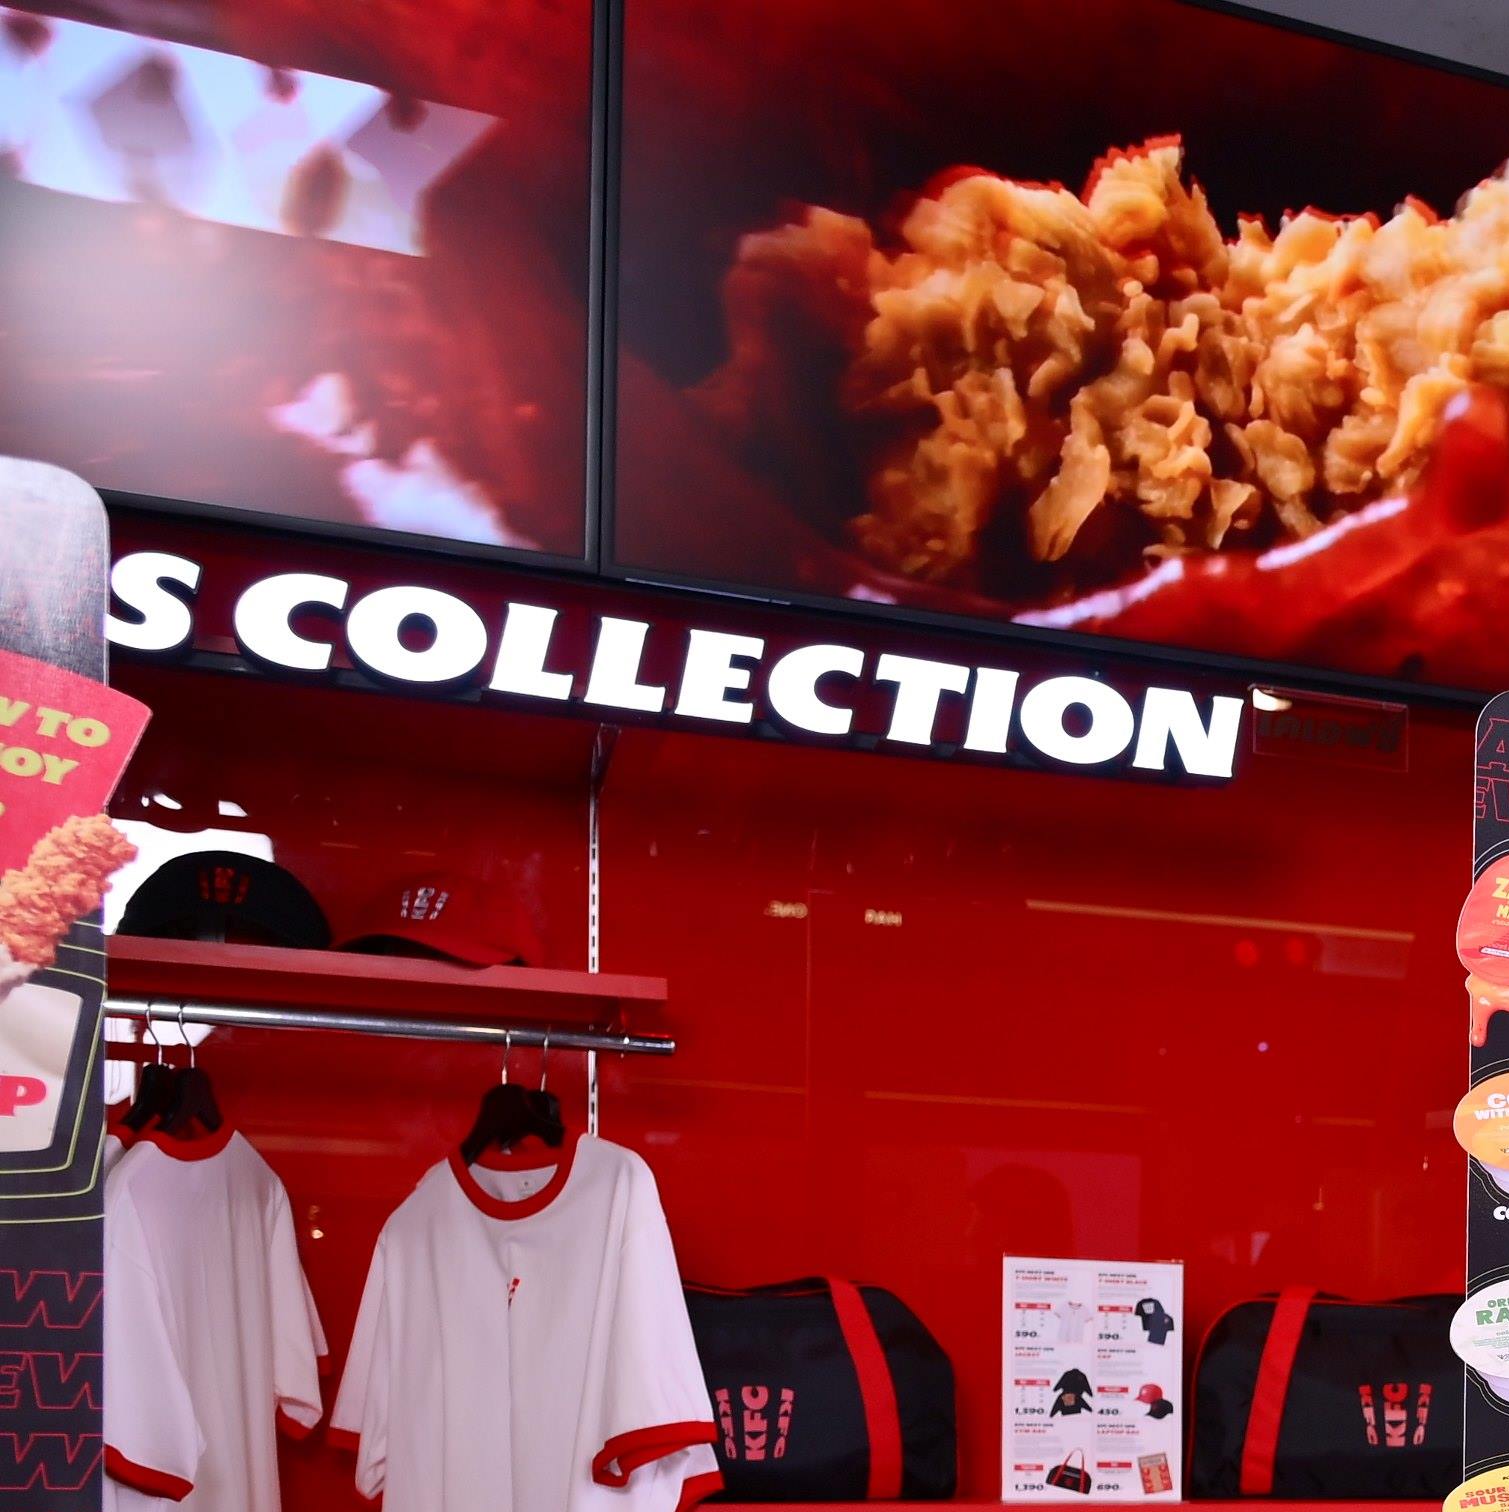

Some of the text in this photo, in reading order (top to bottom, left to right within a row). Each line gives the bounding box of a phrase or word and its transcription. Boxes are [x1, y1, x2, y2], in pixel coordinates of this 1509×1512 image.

[233, 571, 1245, 779] COLLECTION
[36, 706, 111, 748] TO
[0, 742, 80, 785] OY
[1465, 1486, 1506, 1498] SOUR
